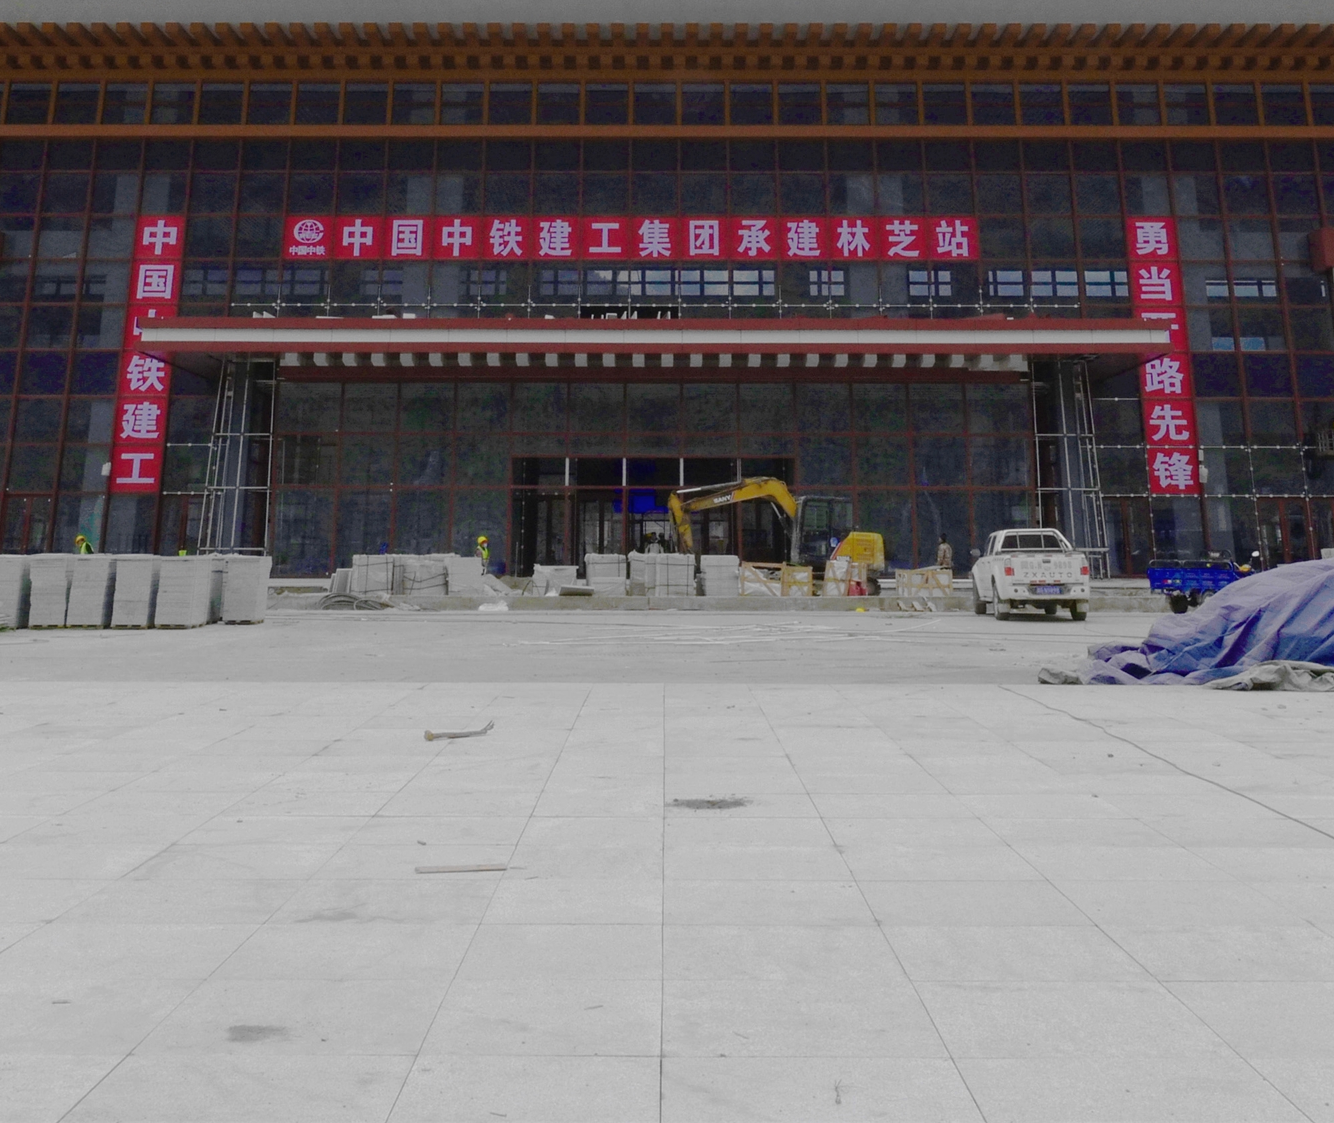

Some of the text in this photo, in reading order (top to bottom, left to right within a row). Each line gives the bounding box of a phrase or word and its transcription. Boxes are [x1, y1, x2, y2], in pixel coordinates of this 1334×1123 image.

[342, 219, 970, 258] 中国中铁建工集团承建林芝站
